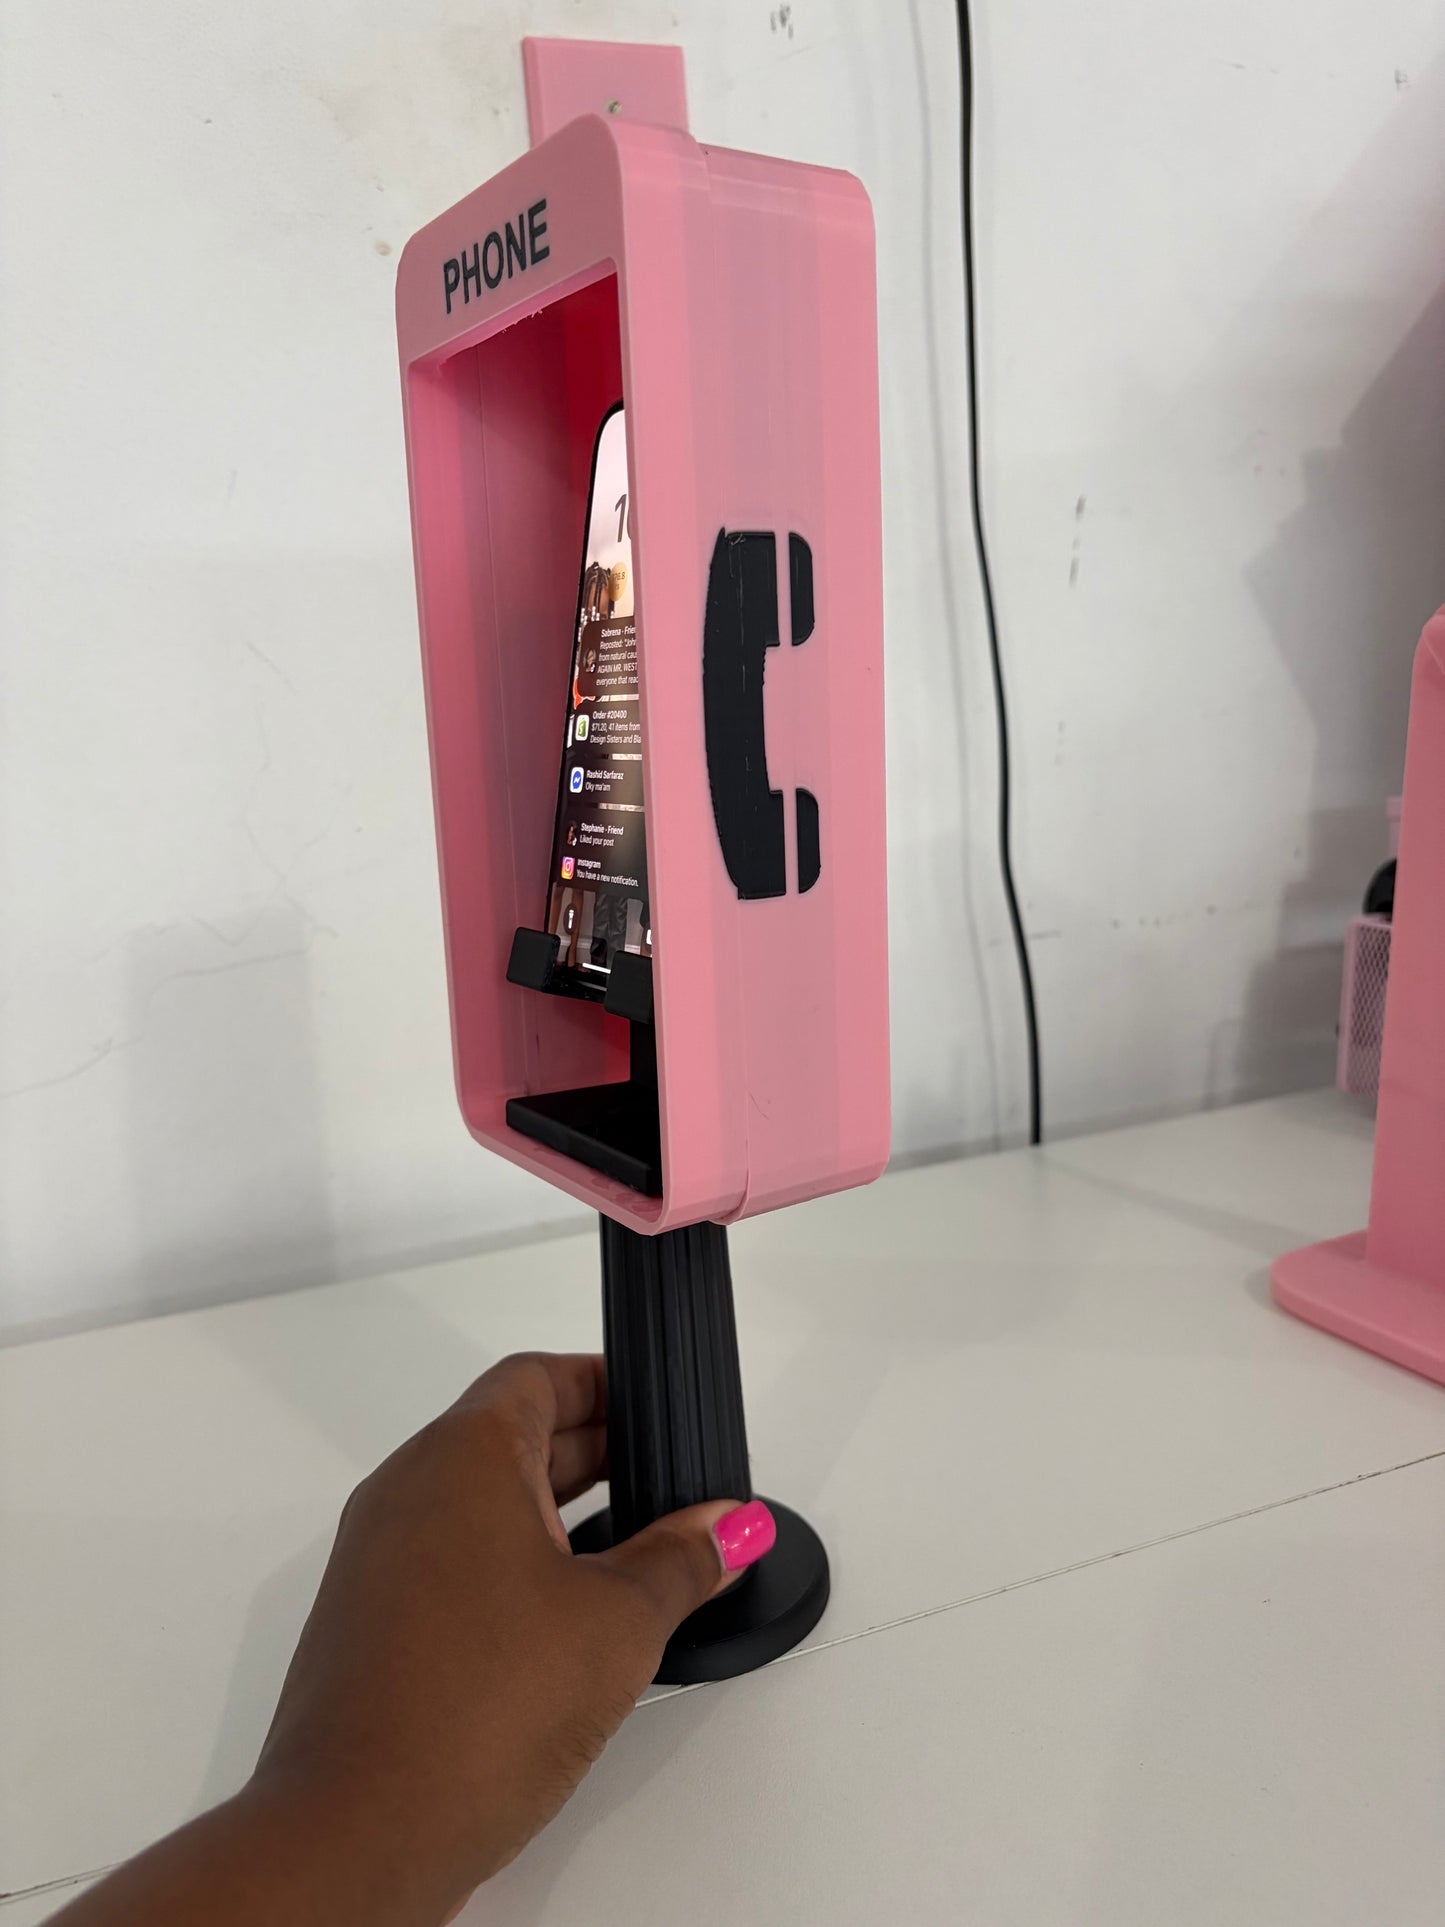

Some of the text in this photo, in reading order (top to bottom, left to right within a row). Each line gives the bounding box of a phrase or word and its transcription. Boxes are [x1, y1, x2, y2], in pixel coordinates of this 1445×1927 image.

[443, 197, 550, 315] PHONE
[615, 494, 632, 543] 1
[599, 653, 610, 662] from
[610, 651, 627, 660] natural
[597, 665, 613, 674] AGAIN
[596, 677, 618, 687] everyone
[618, 675, 628, 685] that
[592, 710, 627, 720] Order #20400
[615, 723, 628, 731] items
[628, 722, 640, 731] from
[590, 735, 606, 745] Design
[607, 735, 623, 744] Sisters
[623, 735, 632, 744] and
[586, 770, 624, 780] Rashid Sarfaraz
[580, 822, 605, 833] Stephanie
[607, 825, 624, 835] Friend
[579, 834, 615, 847] Liked your post
[577, 859, 601, 869] Instagram
[576, 869, 585, 878] You
[585, 871, 597, 880] have
[601, 874, 611, 882] new
[611, 876, 639, 887] notification.
